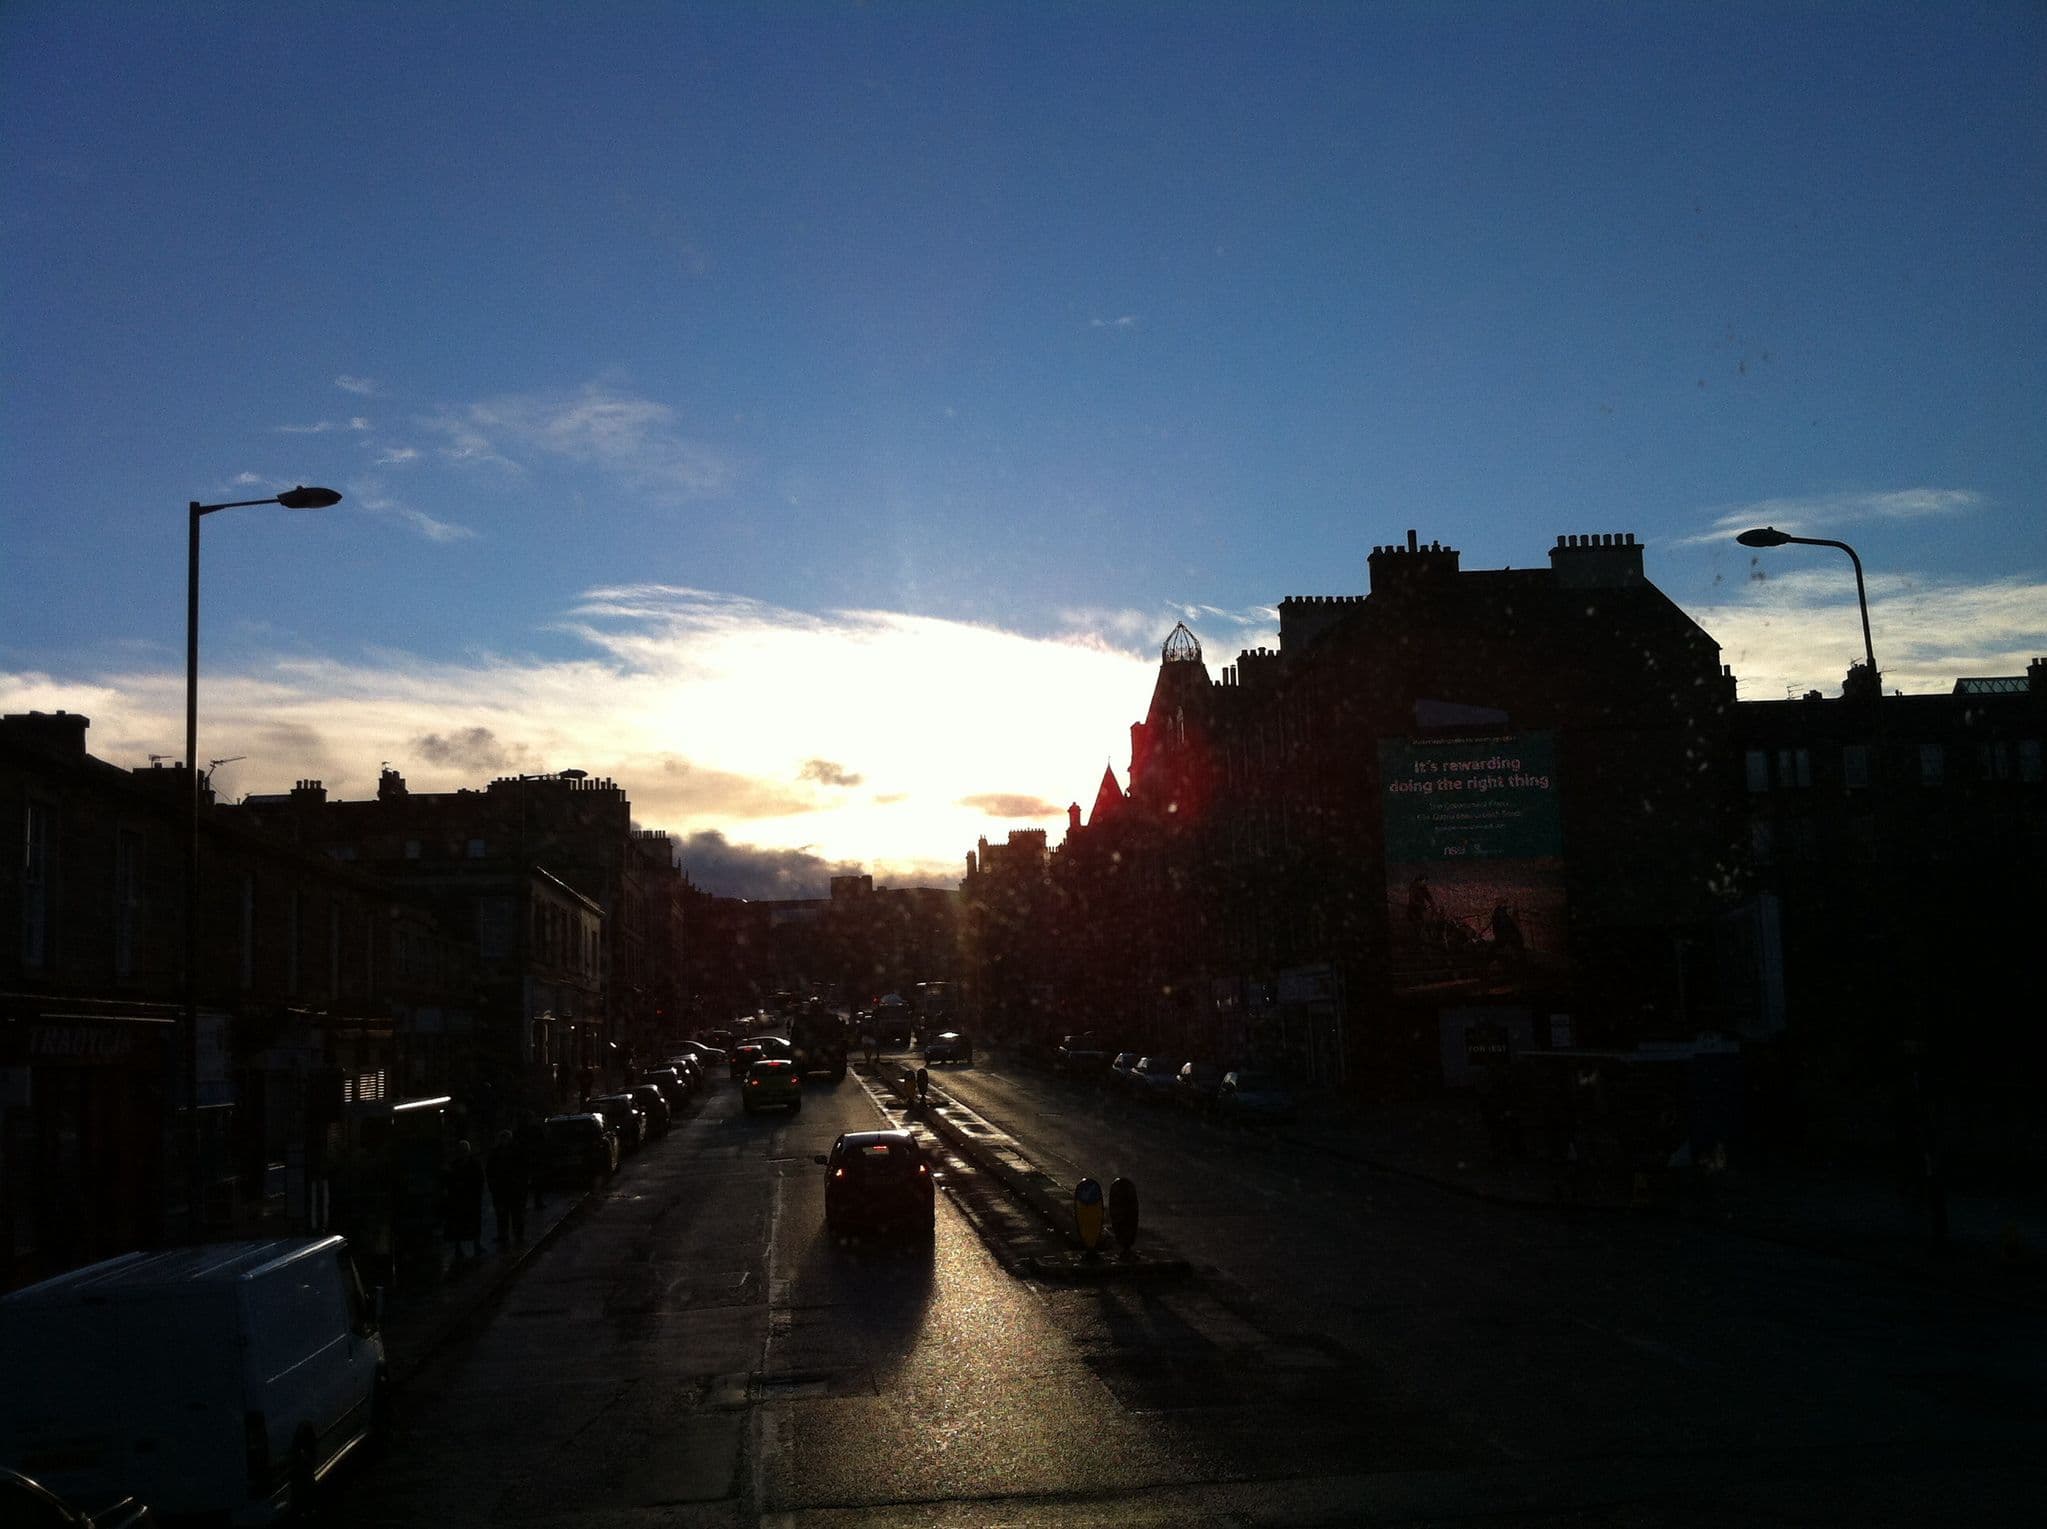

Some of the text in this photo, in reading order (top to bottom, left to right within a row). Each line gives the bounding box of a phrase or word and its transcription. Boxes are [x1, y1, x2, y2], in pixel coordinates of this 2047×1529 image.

[1414, 756, 1521, 773] It's rewarding
[1389, 779, 1434, 794] doing
[1437, 777, 1463, 791] the
[1466, 775, 1505, 793] right
